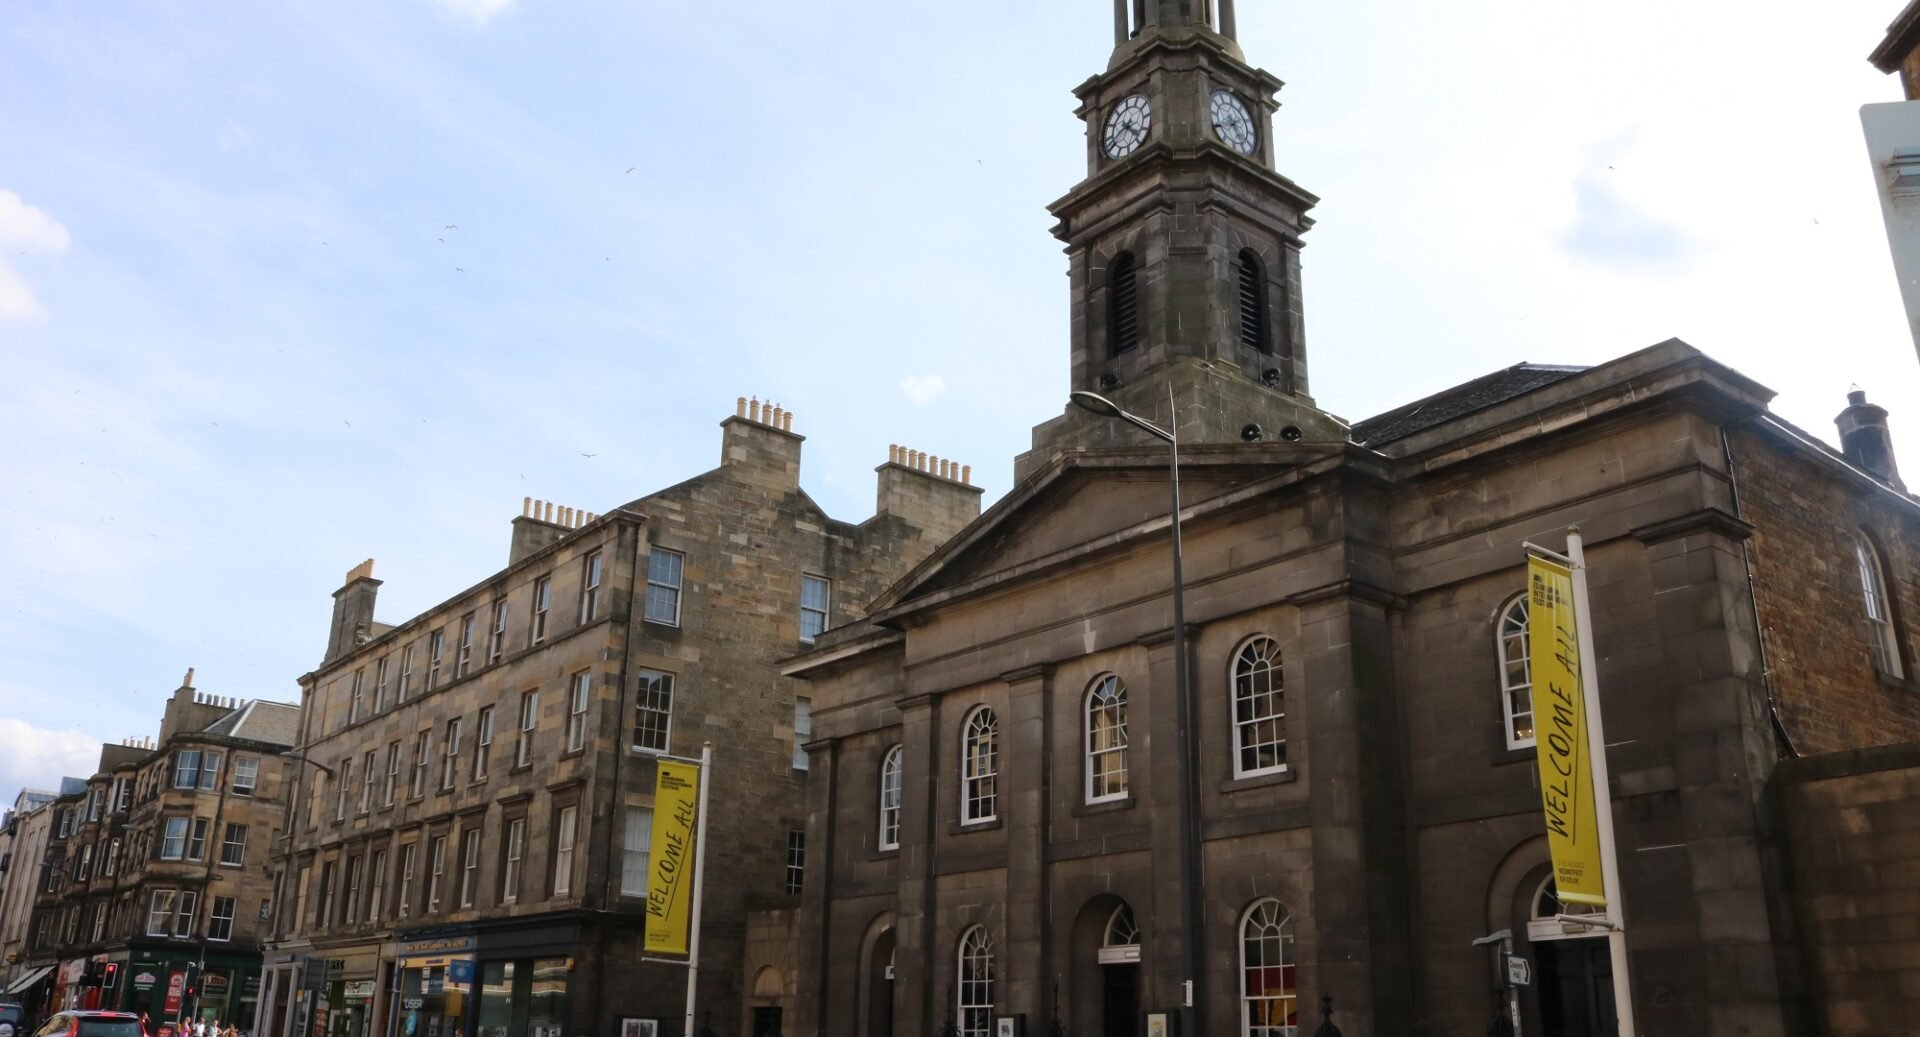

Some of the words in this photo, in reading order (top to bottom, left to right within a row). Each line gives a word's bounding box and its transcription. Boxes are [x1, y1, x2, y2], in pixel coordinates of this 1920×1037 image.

[1554, 626, 1576, 680] ALL
[1547, 681, 1574, 839] WELCOME
[646, 831, 683, 918] WELCOME
[674, 799, 694, 829] ALL
